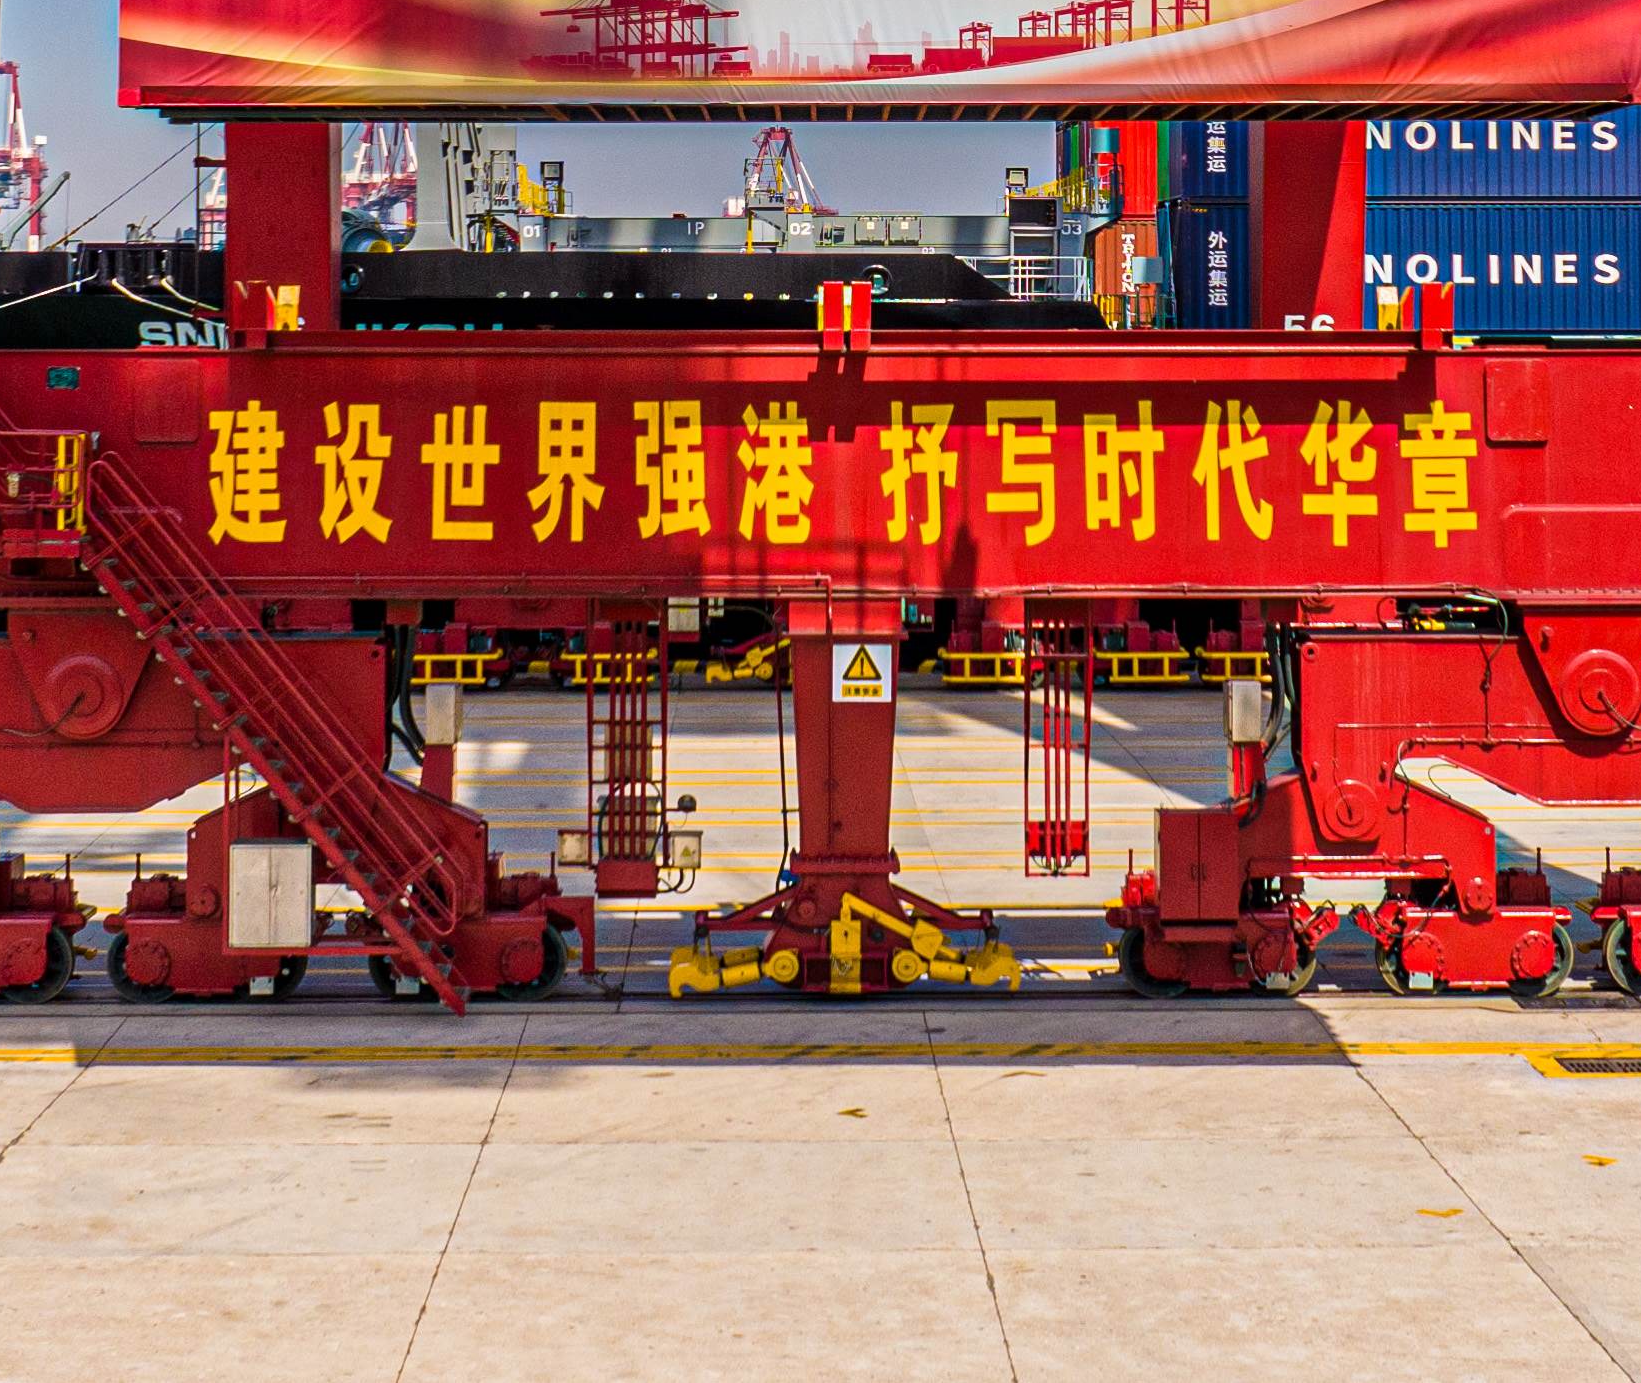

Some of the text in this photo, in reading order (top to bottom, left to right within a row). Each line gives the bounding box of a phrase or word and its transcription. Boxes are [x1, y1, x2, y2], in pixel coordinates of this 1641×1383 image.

[1366, 121, 1619, 150] NOLINES
[523, 225, 541, 238] 01
[789, 222, 812, 235] 02
[1207, 230, 1228, 307] 外运集运
[1365, 253, 1621, 284] NOLINES
[207, 400, 1479, 548] 建设世界强港 抒写时代华章
